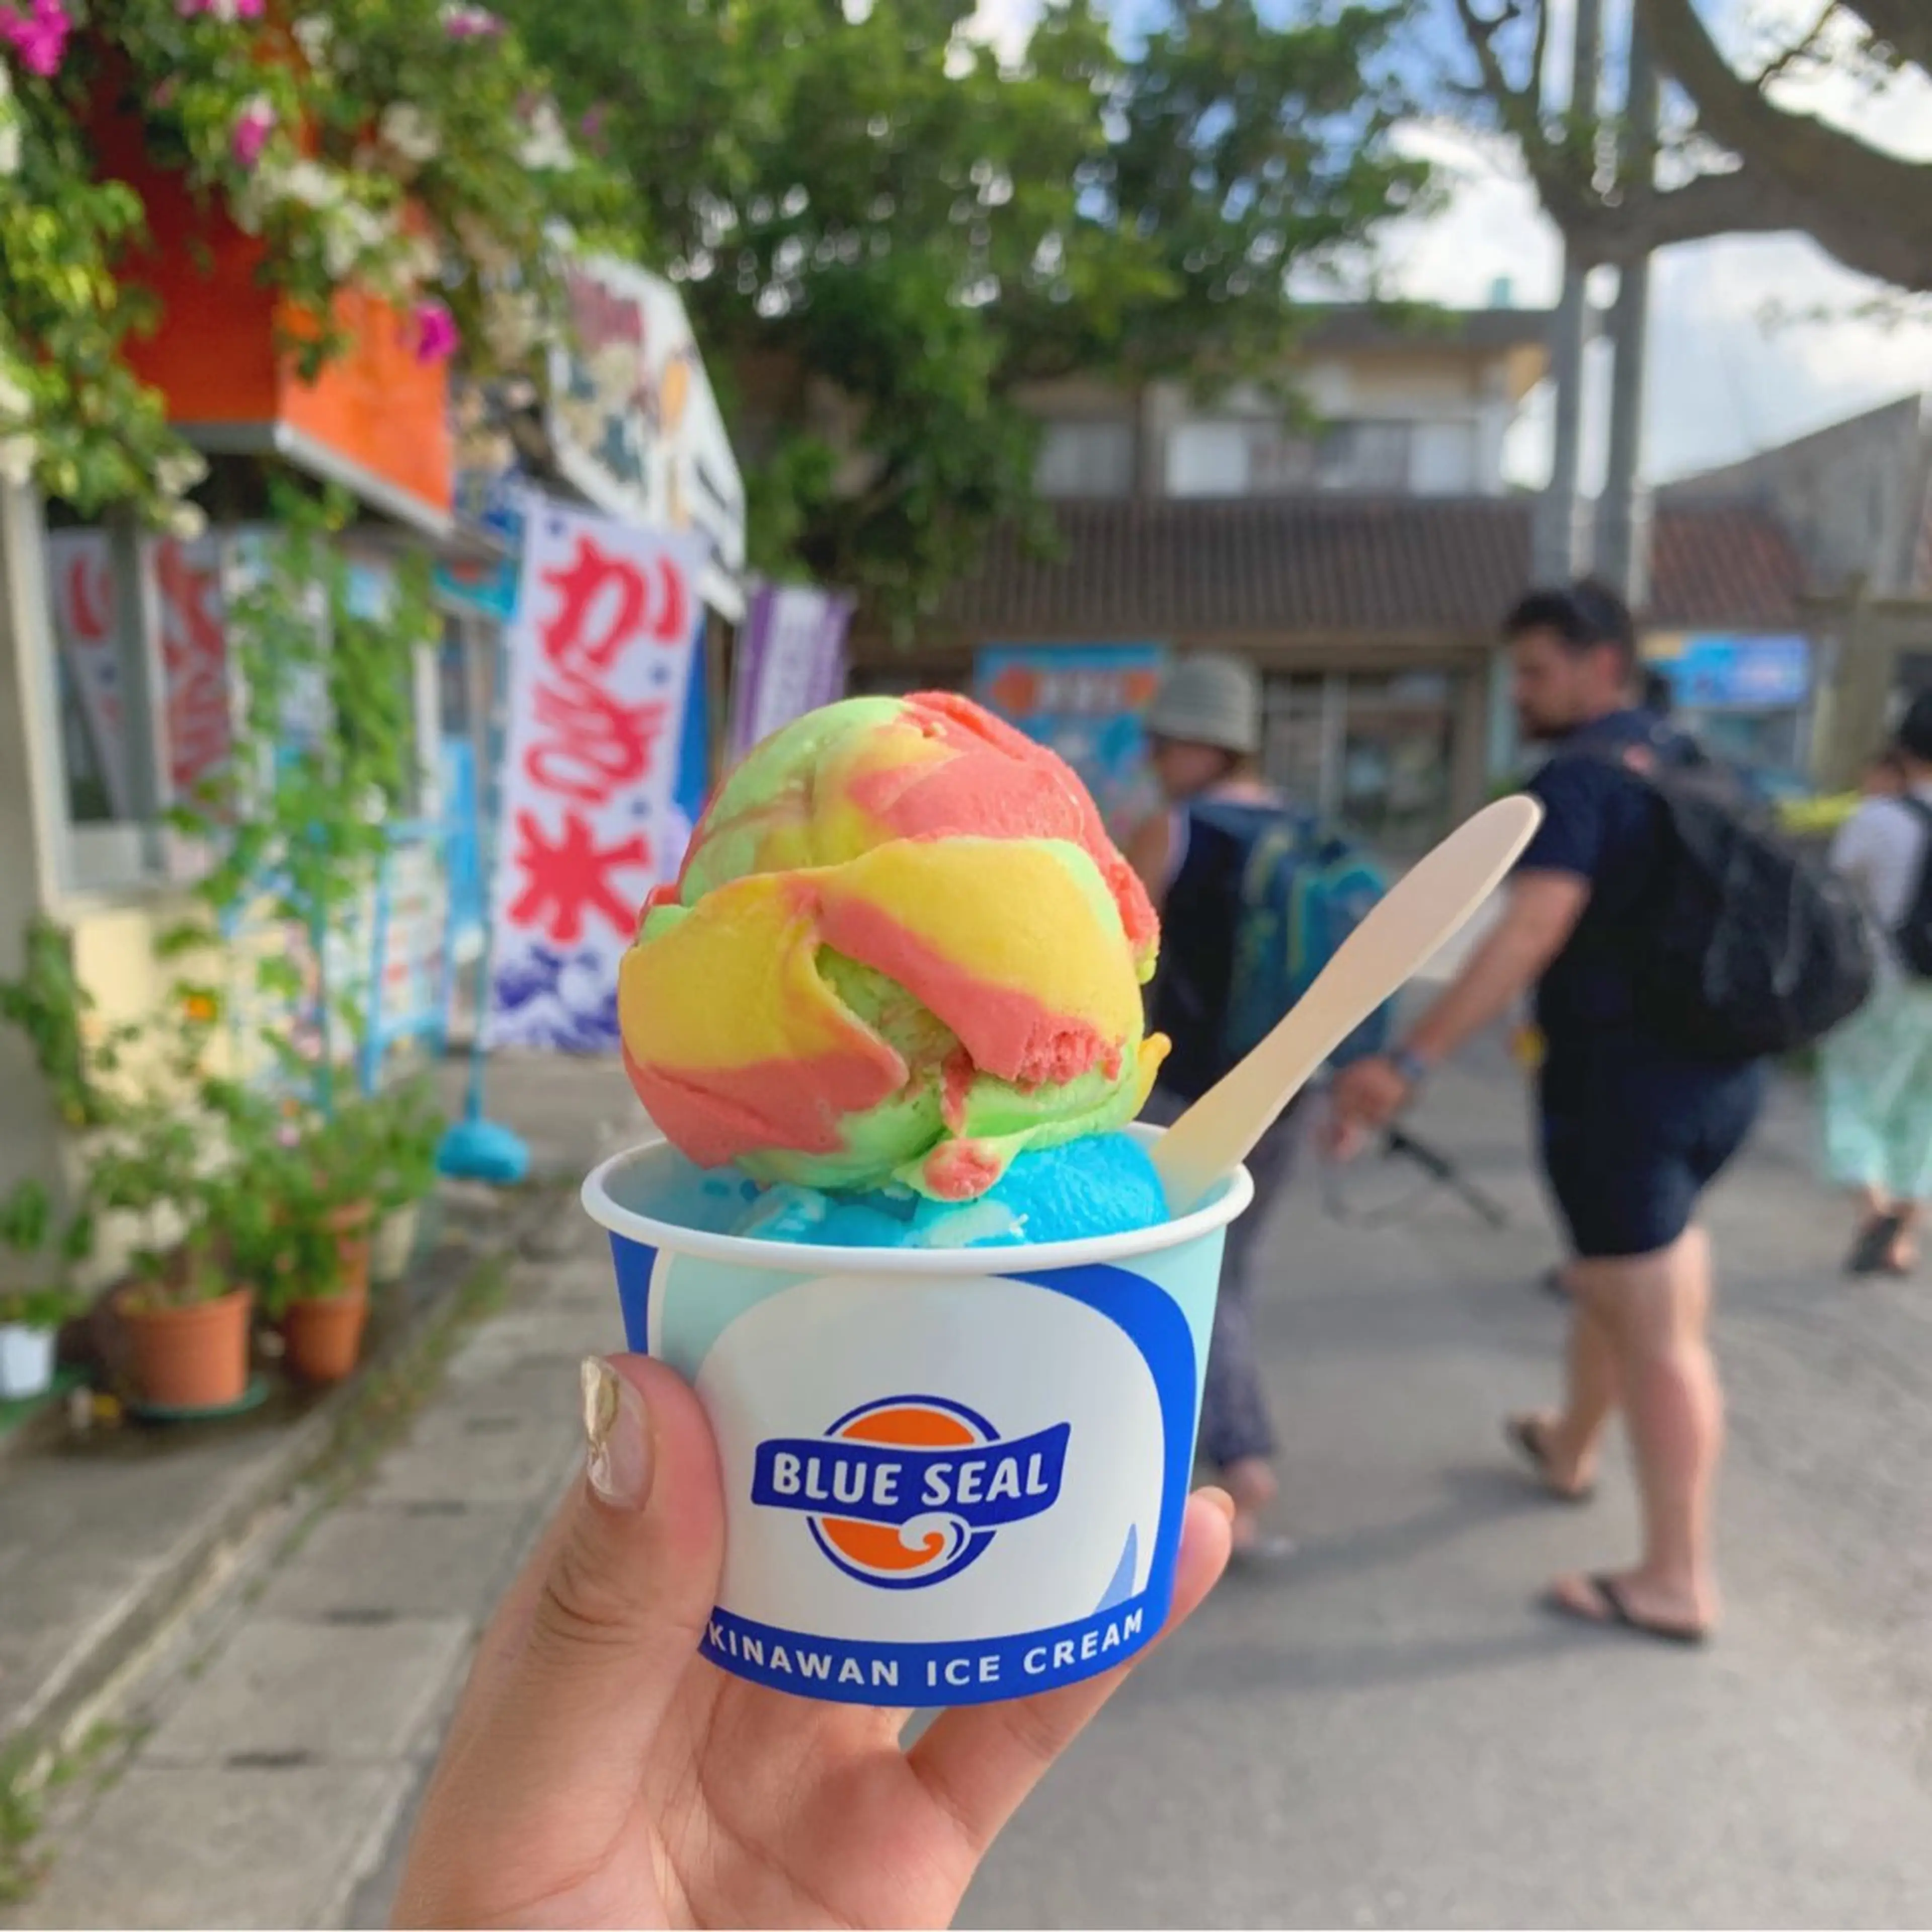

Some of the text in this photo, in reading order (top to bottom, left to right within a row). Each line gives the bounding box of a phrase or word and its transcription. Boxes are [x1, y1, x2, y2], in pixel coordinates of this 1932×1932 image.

[772, 1452, 1049, 1506] BLUE SEAL
[708, 1607, 1143, 1686] KINAWAN ICE CREAM
